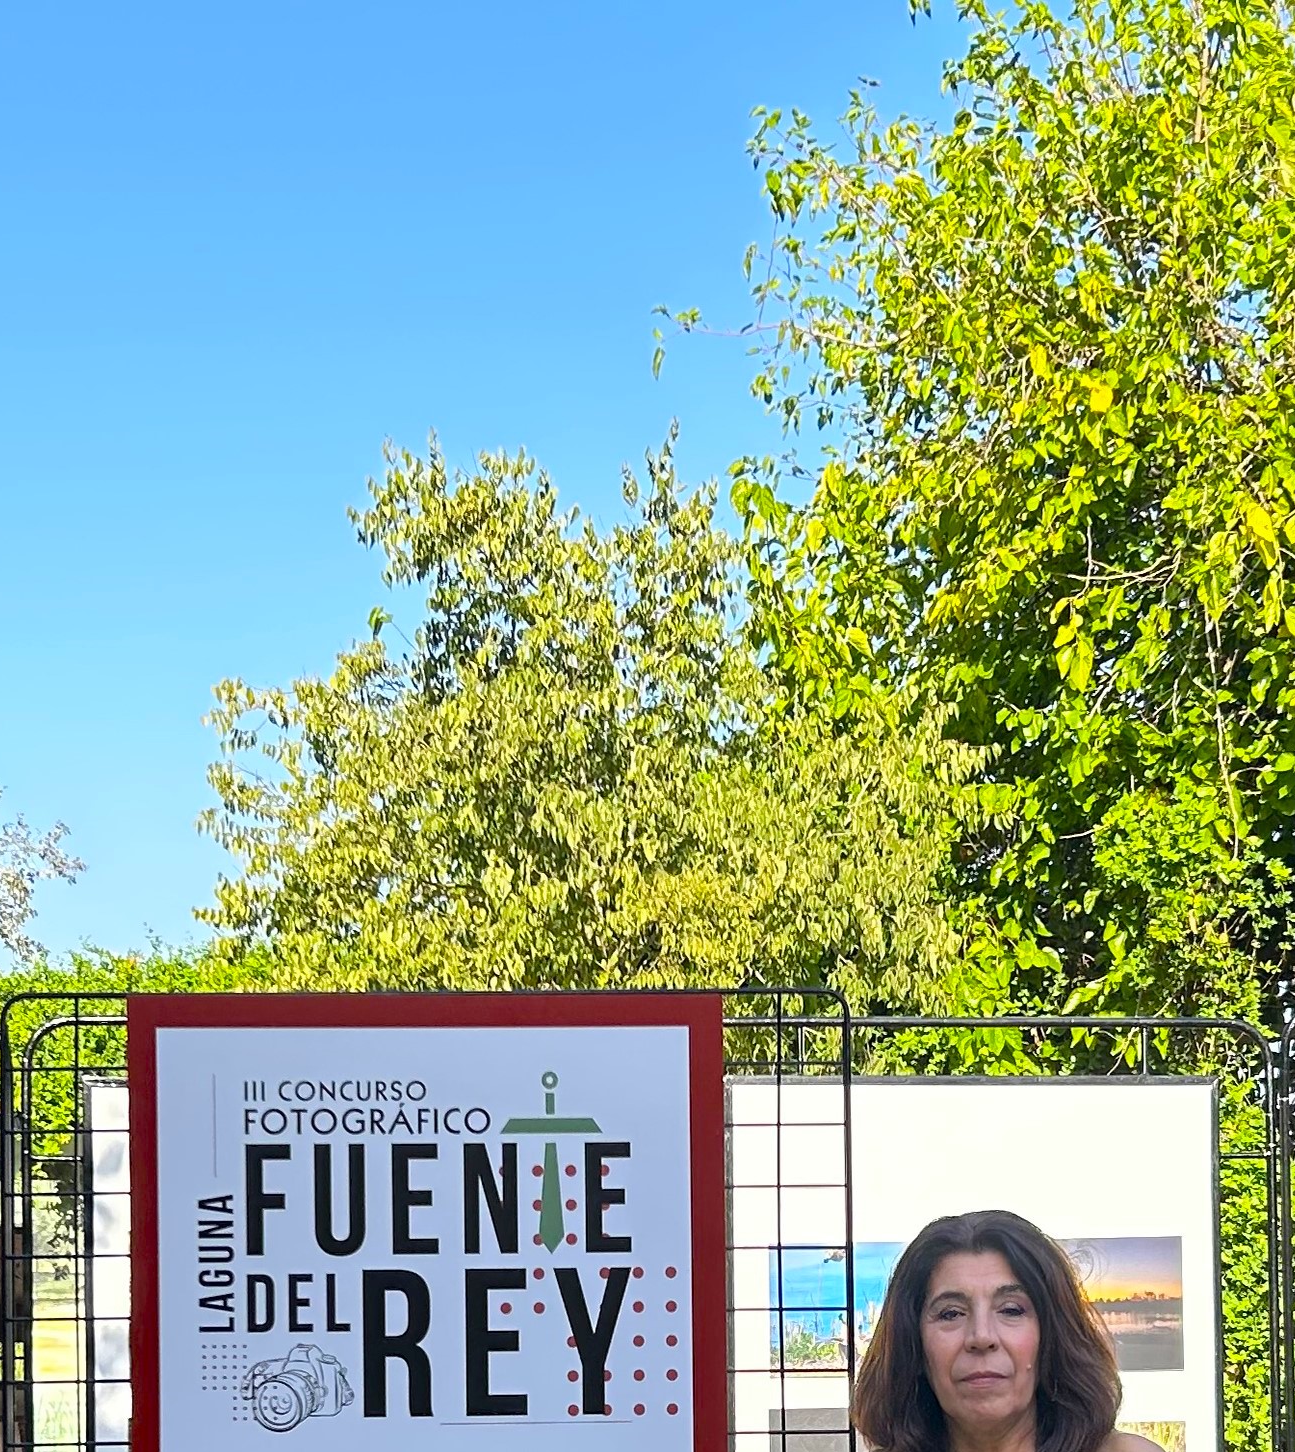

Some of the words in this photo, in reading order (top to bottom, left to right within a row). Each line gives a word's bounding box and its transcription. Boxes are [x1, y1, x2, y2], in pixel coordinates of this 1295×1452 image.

[243, 1080, 266, 1102] III
[278, 1080, 427, 1102] CONCURSO
[243, 1102, 491, 1136] FOTOGRÁFICO
[245, 1118, 633, 1257] FUENTE
[197, 1193, 235, 1335] LAGUNA
[246, 1273, 352, 1334] DEL
[362, 1266, 633, 1418] REY
